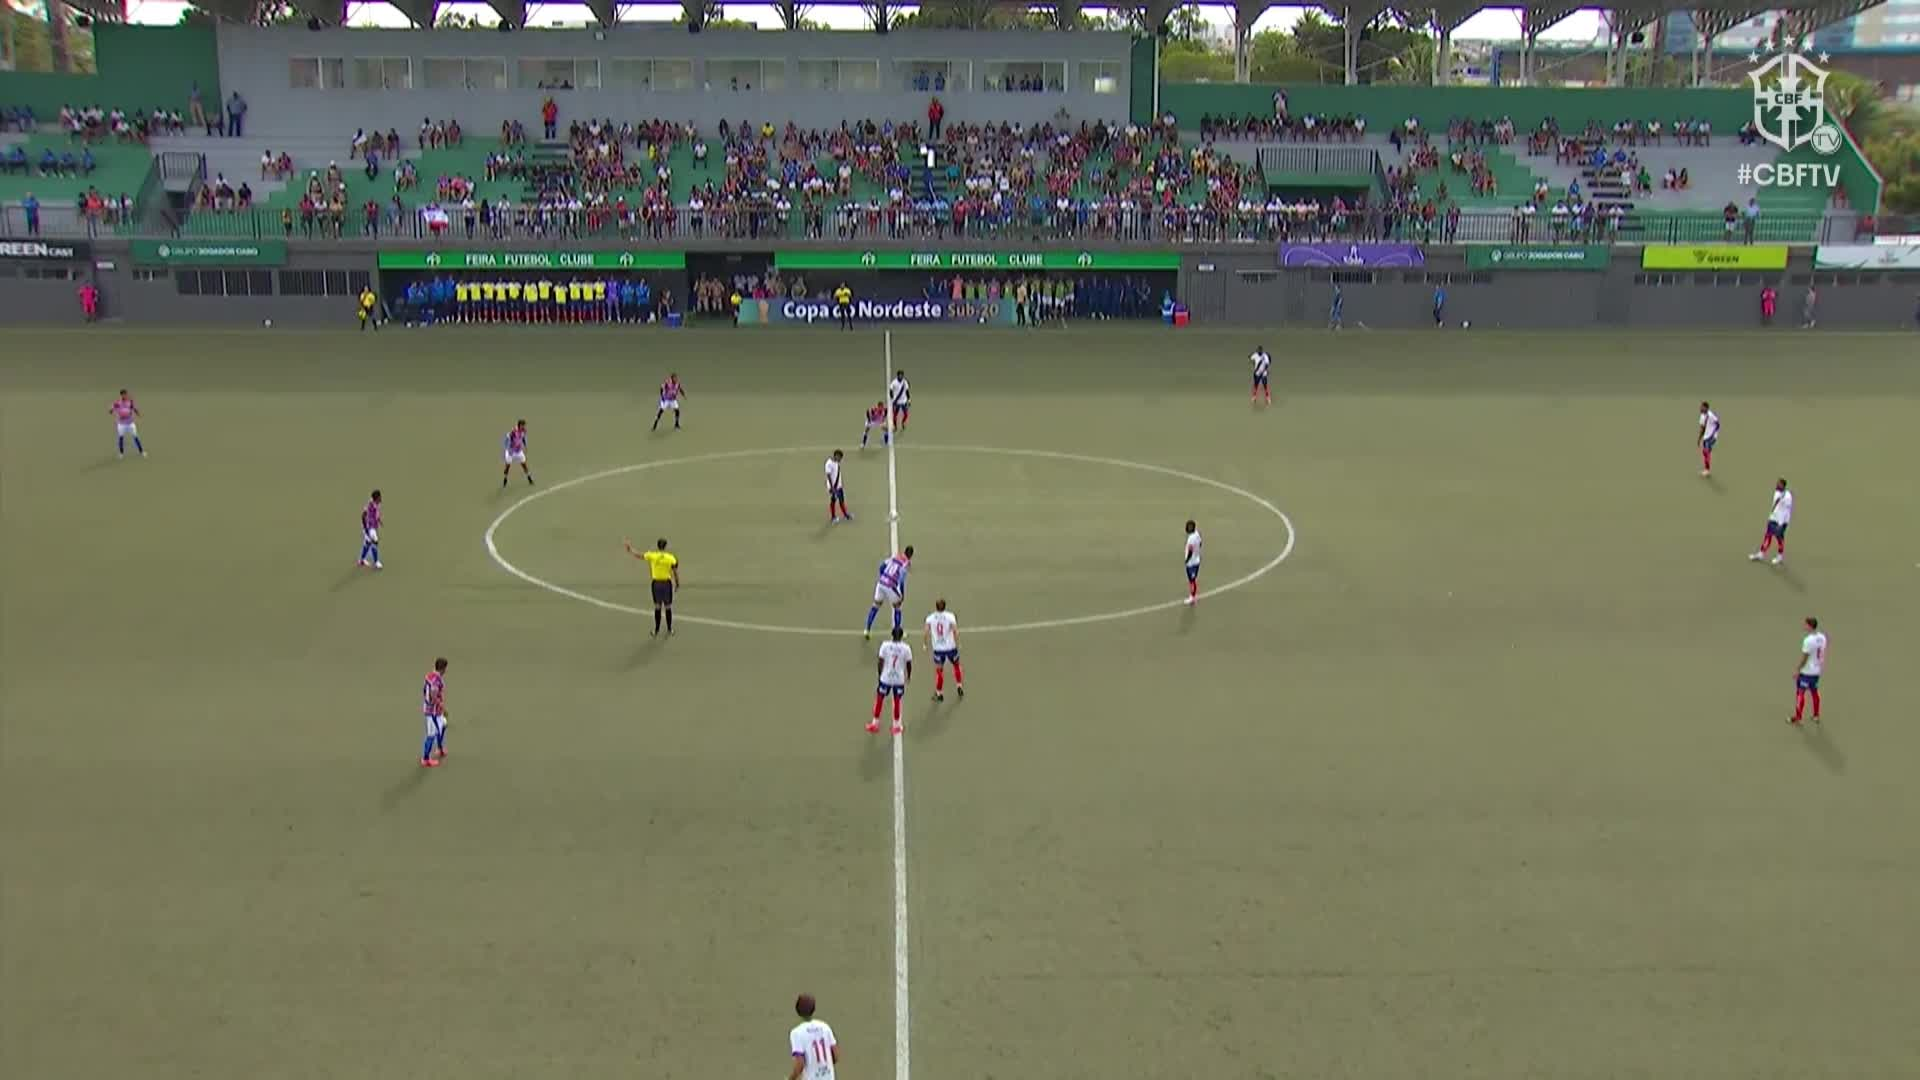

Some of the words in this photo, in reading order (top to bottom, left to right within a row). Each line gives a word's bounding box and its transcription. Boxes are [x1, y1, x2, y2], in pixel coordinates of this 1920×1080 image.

[466, 254, 496, 266] FEIRA
[505, 254, 552, 266] FUTEBOL
[560, 254, 594, 266] CLUBE
[910, 254, 940, 266] FEIRA
[952, 254, 998, 266] FUTEBOL
[1009, 254, 1043, 266] CLUBE
[1707, 255, 1740, 264] GREEN
[783, 301, 829, 322] Copa
[859, 300, 942, 318] Nordeste
[892, 655, 899, 669] 7
[812, 1037, 828, 1063] 11
